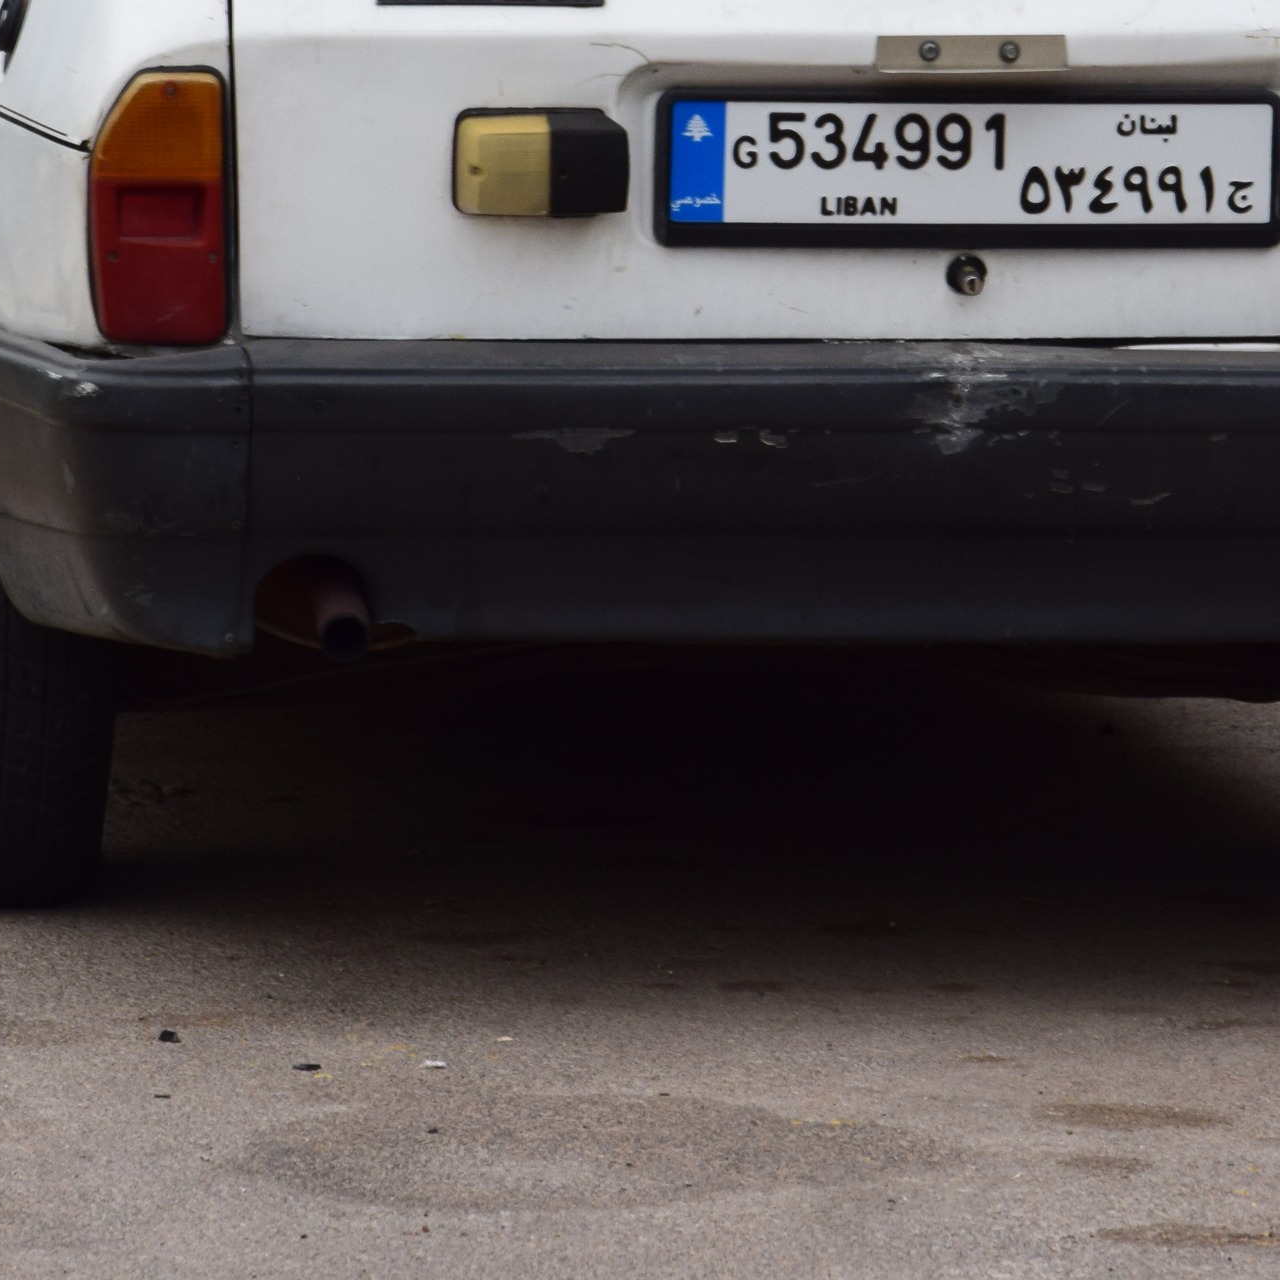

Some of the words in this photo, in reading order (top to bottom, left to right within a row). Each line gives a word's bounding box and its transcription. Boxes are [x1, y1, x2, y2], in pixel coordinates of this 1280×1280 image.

[1116, 113, 1178, 143] لبنان
[670, 193, 721, 212] خصوصي
[821, 195, 898, 217] LIBAN
